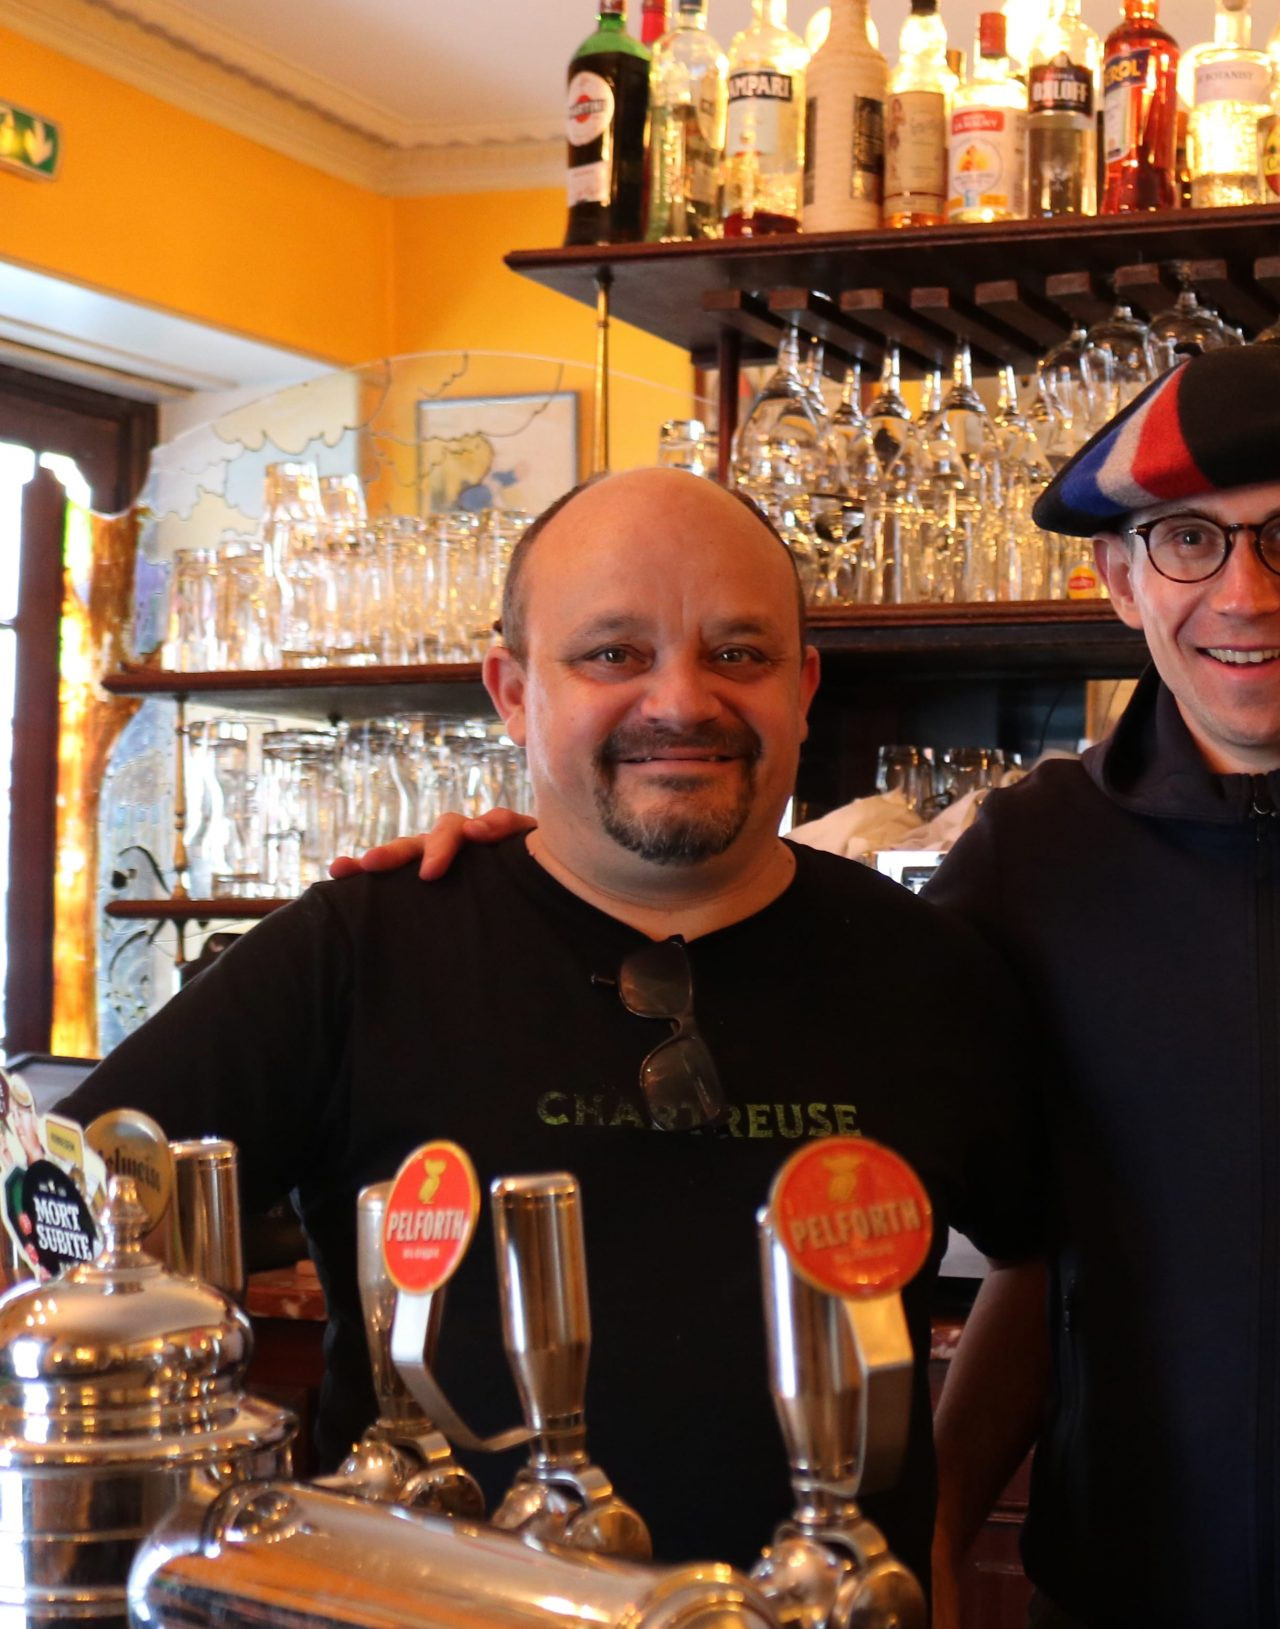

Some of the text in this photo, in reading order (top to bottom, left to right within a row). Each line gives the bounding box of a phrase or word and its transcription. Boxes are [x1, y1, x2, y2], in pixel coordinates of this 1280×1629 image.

[730, 74, 790, 98] AMPARI
[33, 1197, 81, 1232] MORT
[386, 1209, 464, 1242] PELFORTH
[789, 1198, 921, 1253] PELFORTH
[36, 1225, 93, 1262] SUBITE
